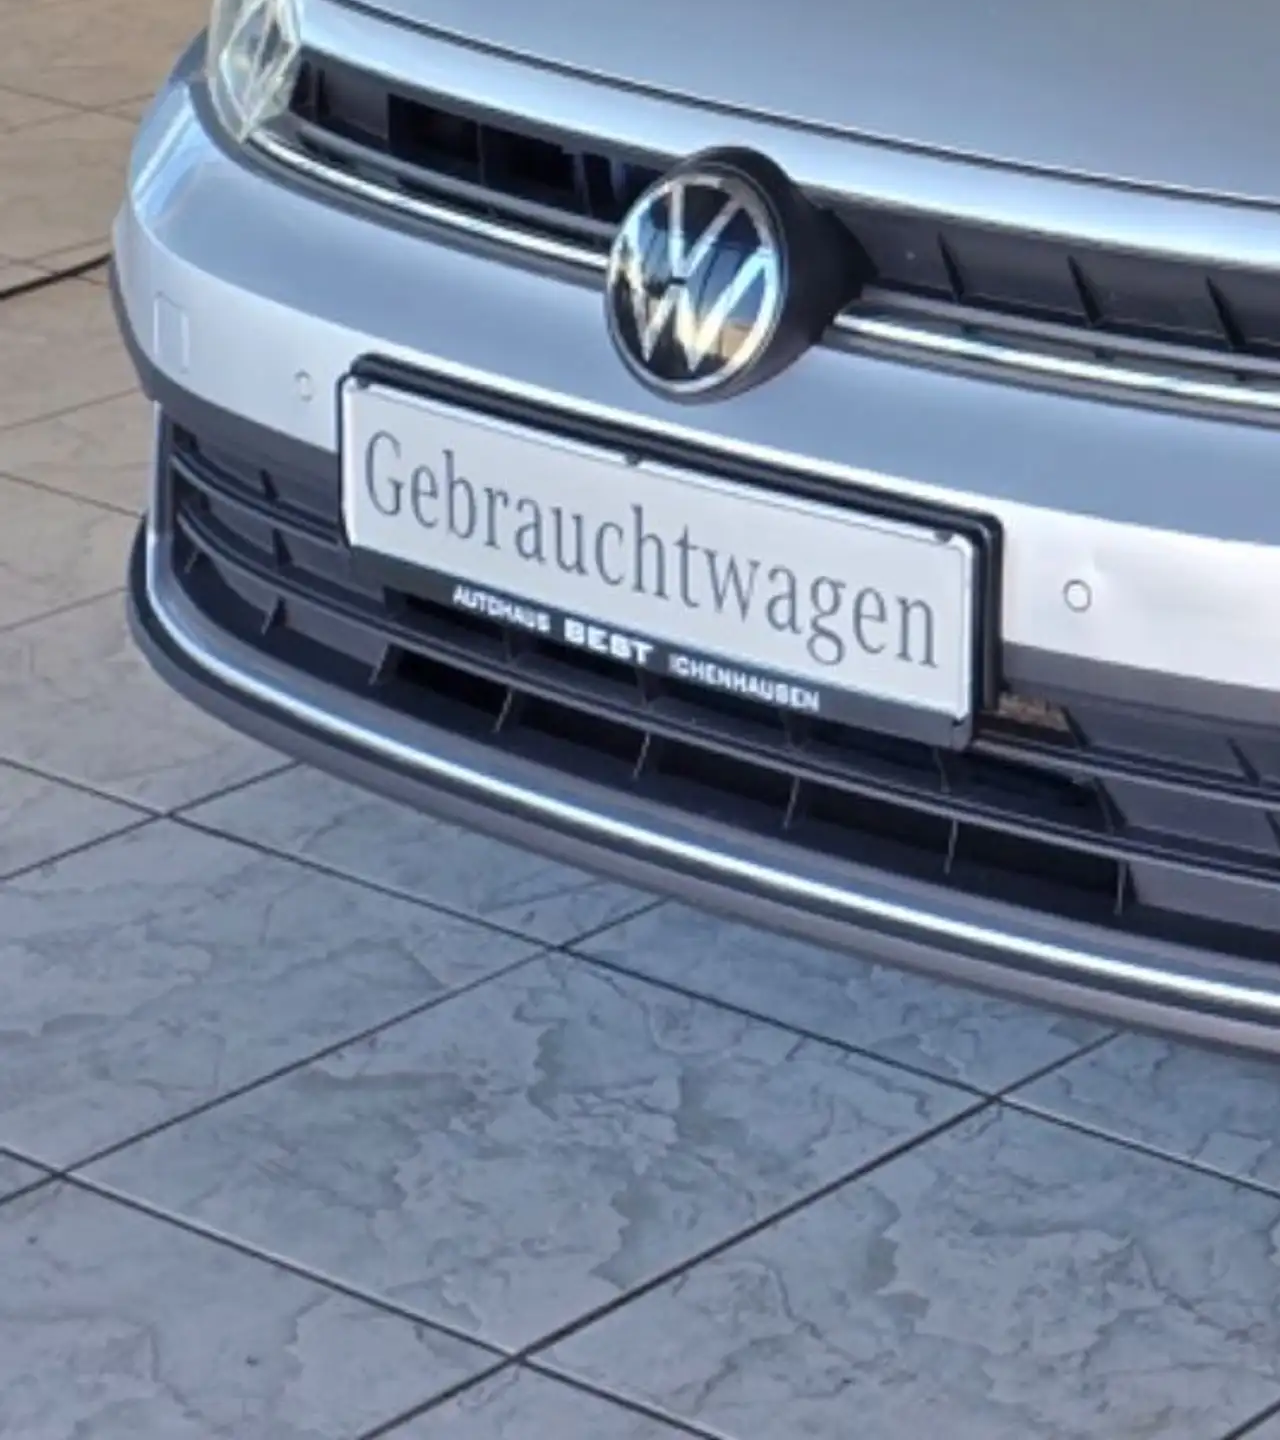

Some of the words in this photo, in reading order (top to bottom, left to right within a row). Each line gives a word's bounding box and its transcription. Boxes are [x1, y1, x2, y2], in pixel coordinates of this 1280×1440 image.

[606, 169, 780, 397] VW
[364, 430, 938, 669] Gebrauchtwagen
[452, 583, 551, 633] AUTOHAUS
[563, 616, 655, 666] BEST
[668, 652, 821, 713] ICHENHAUSEN
